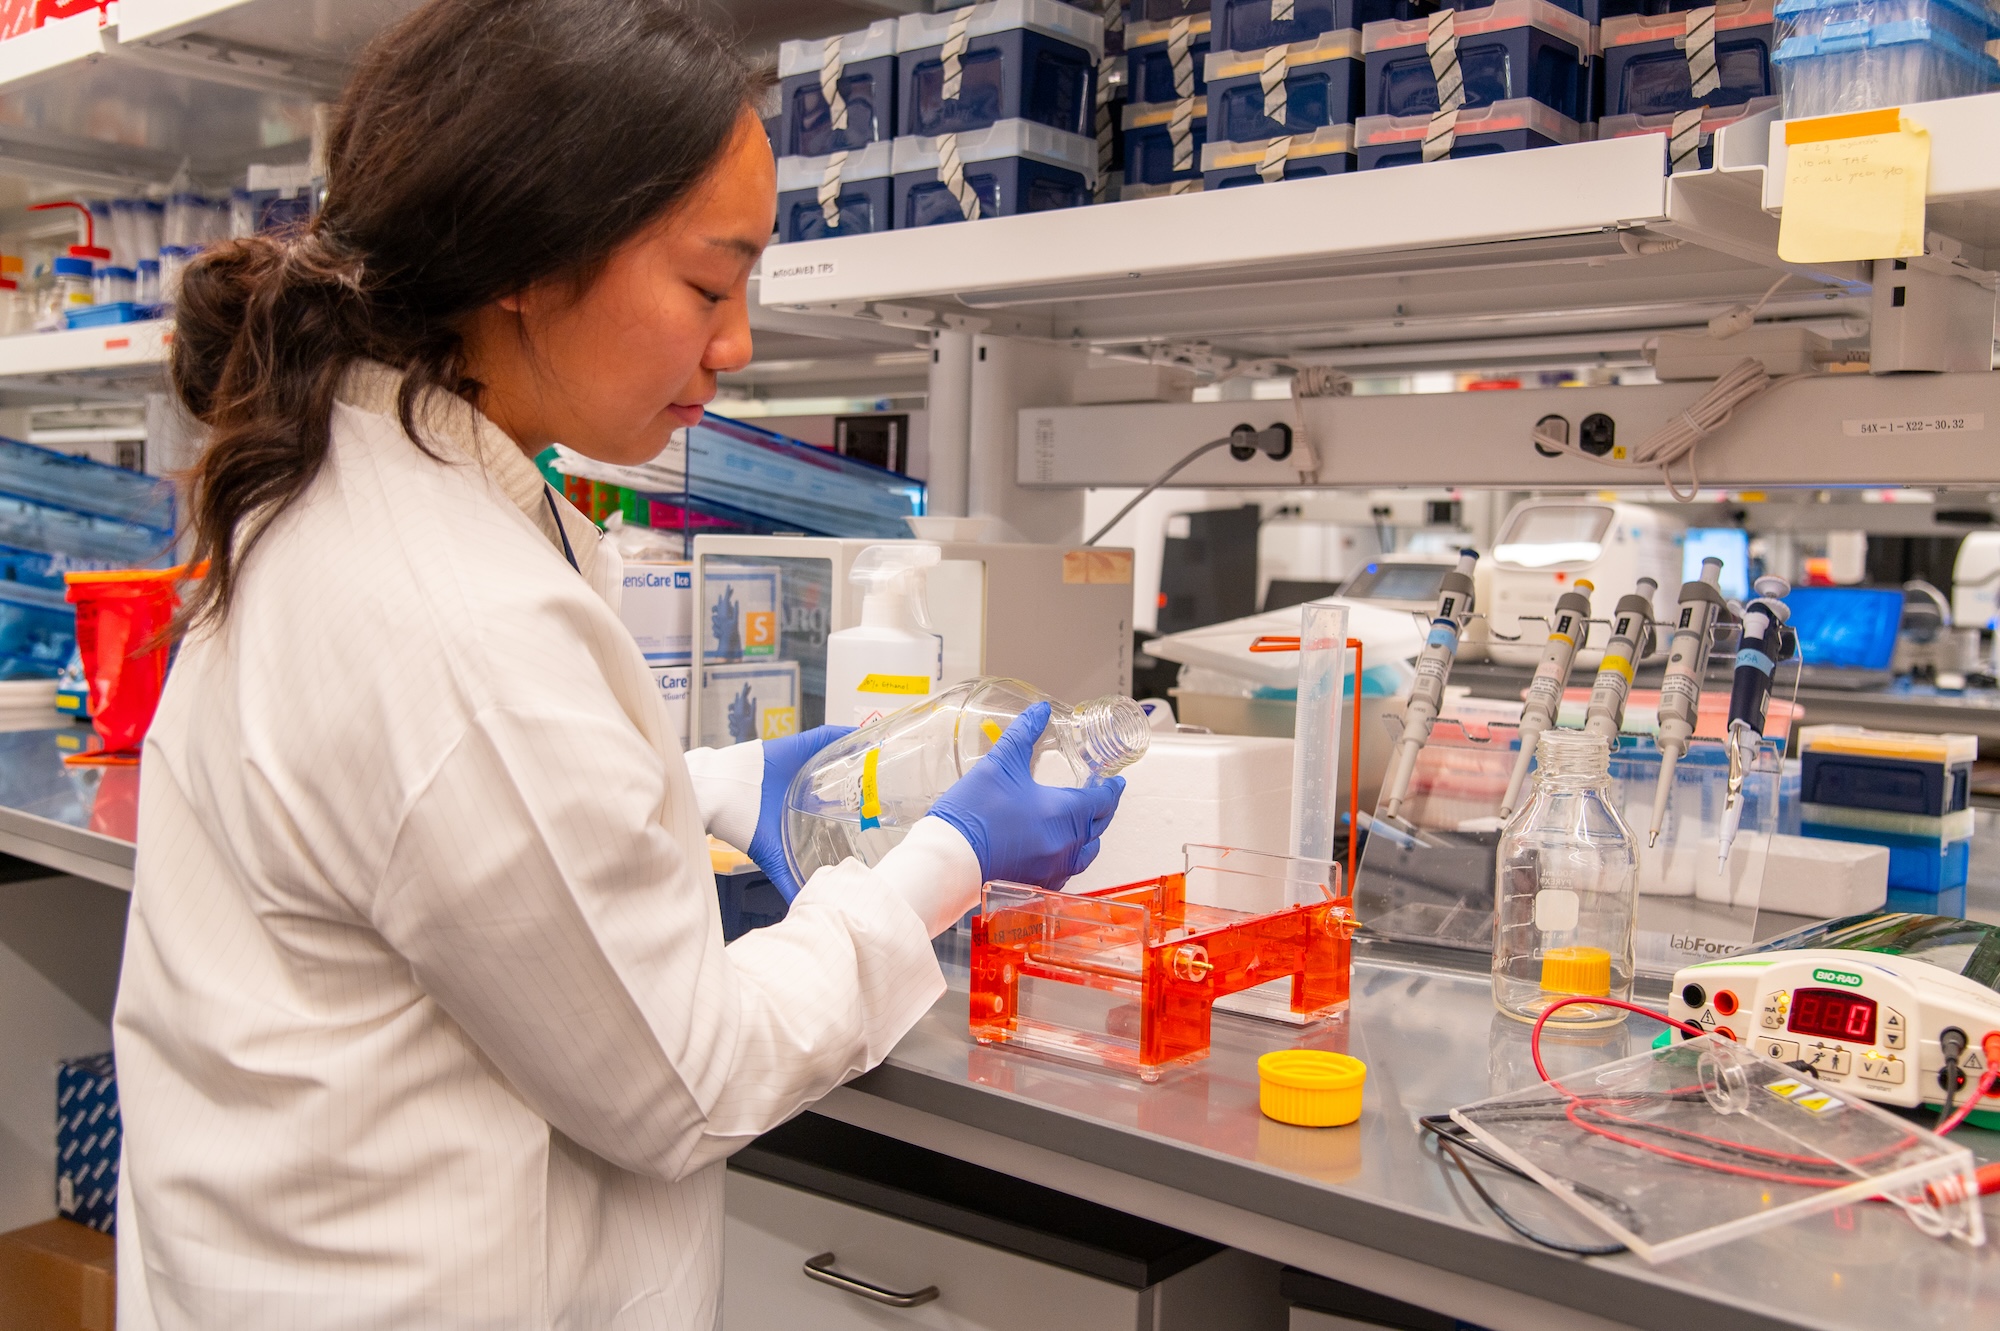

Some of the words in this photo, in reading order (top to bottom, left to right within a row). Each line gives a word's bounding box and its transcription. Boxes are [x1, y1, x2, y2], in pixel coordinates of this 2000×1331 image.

[817, 263, 834, 275] TIPS
[675, 574, 689, 588] Ice
[754, 616, 768, 642] S
[881, 681, 909, 691] Ethanol
[766, 713, 793, 739] XS
[1764, 1006, 1776, 1014] mA
[1866, 1084, 1892, 1093] constant
